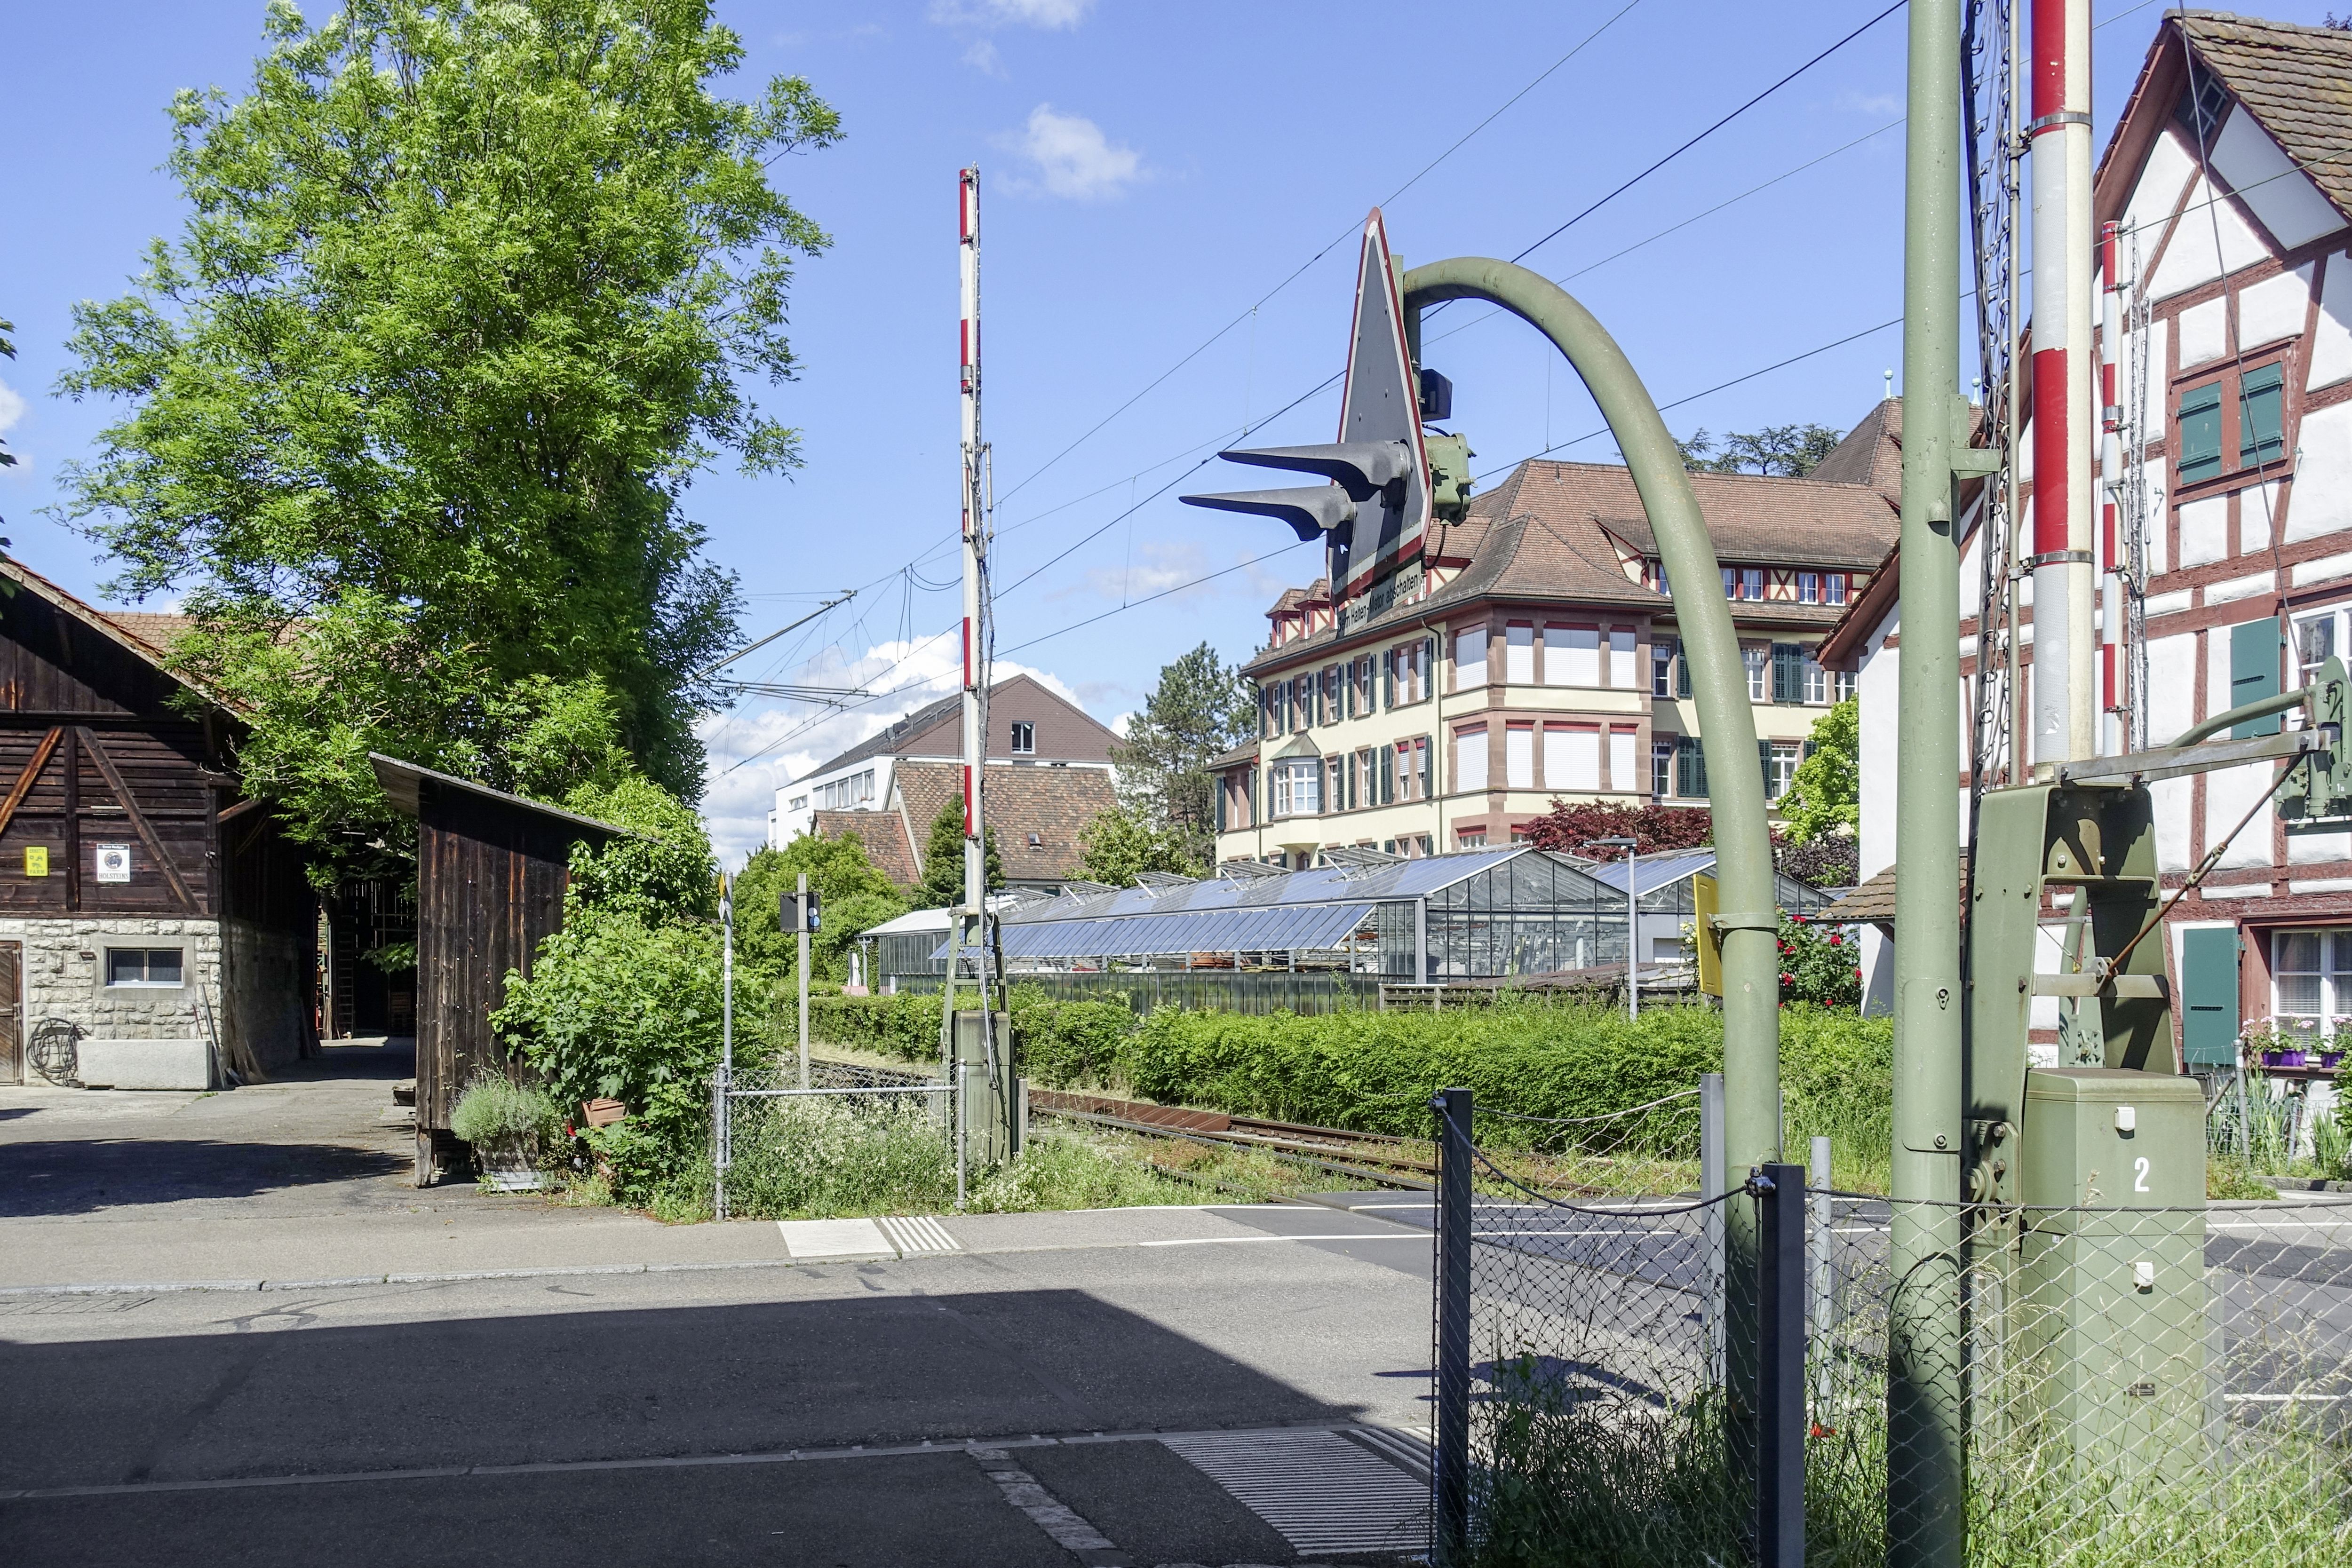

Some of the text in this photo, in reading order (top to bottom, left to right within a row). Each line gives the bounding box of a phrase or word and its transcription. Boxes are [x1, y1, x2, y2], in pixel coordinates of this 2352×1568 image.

[1386, 574, 1418, 603] abschalten
[2336, 783, 2345, 792] 1a
[2135, 1156, 2149, 1192] 2
